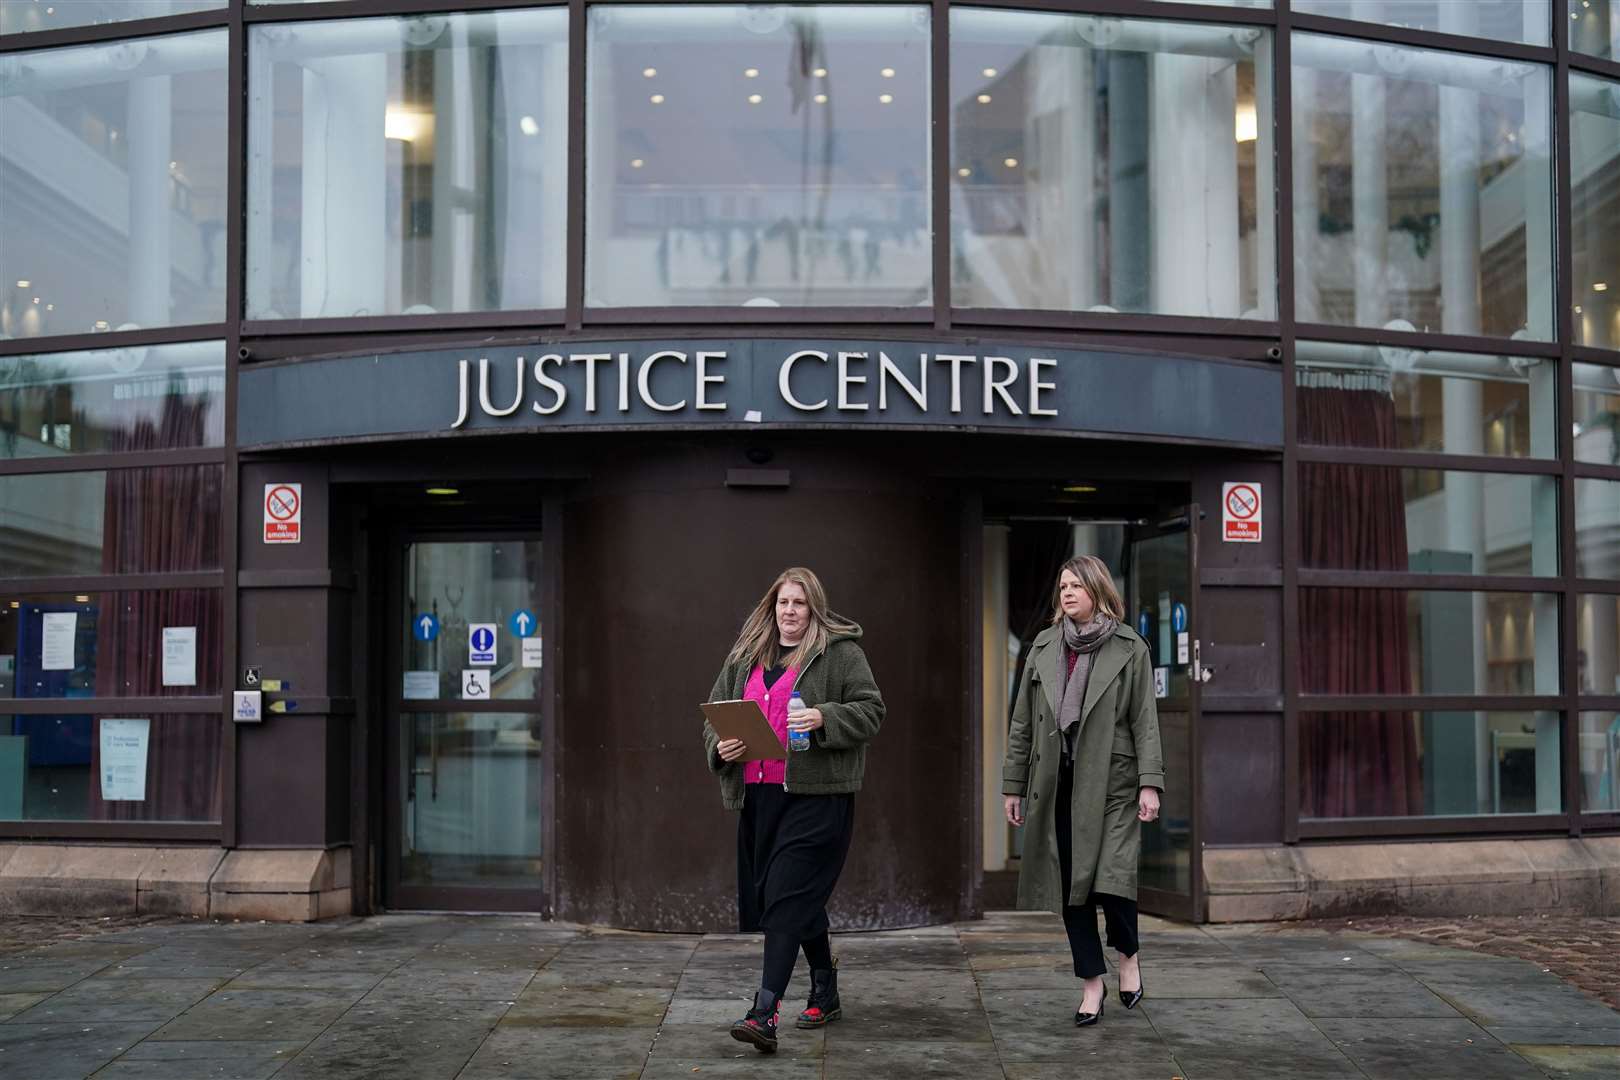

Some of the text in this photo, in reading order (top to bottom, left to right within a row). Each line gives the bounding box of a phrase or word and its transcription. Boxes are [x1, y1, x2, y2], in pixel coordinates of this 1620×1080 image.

[450, 350, 1058, 428] JUSTICE CENTRE
[277, 523, 288, 531] No
[267, 531, 297, 539] smoking
[1227, 530, 1258, 538] smoking
